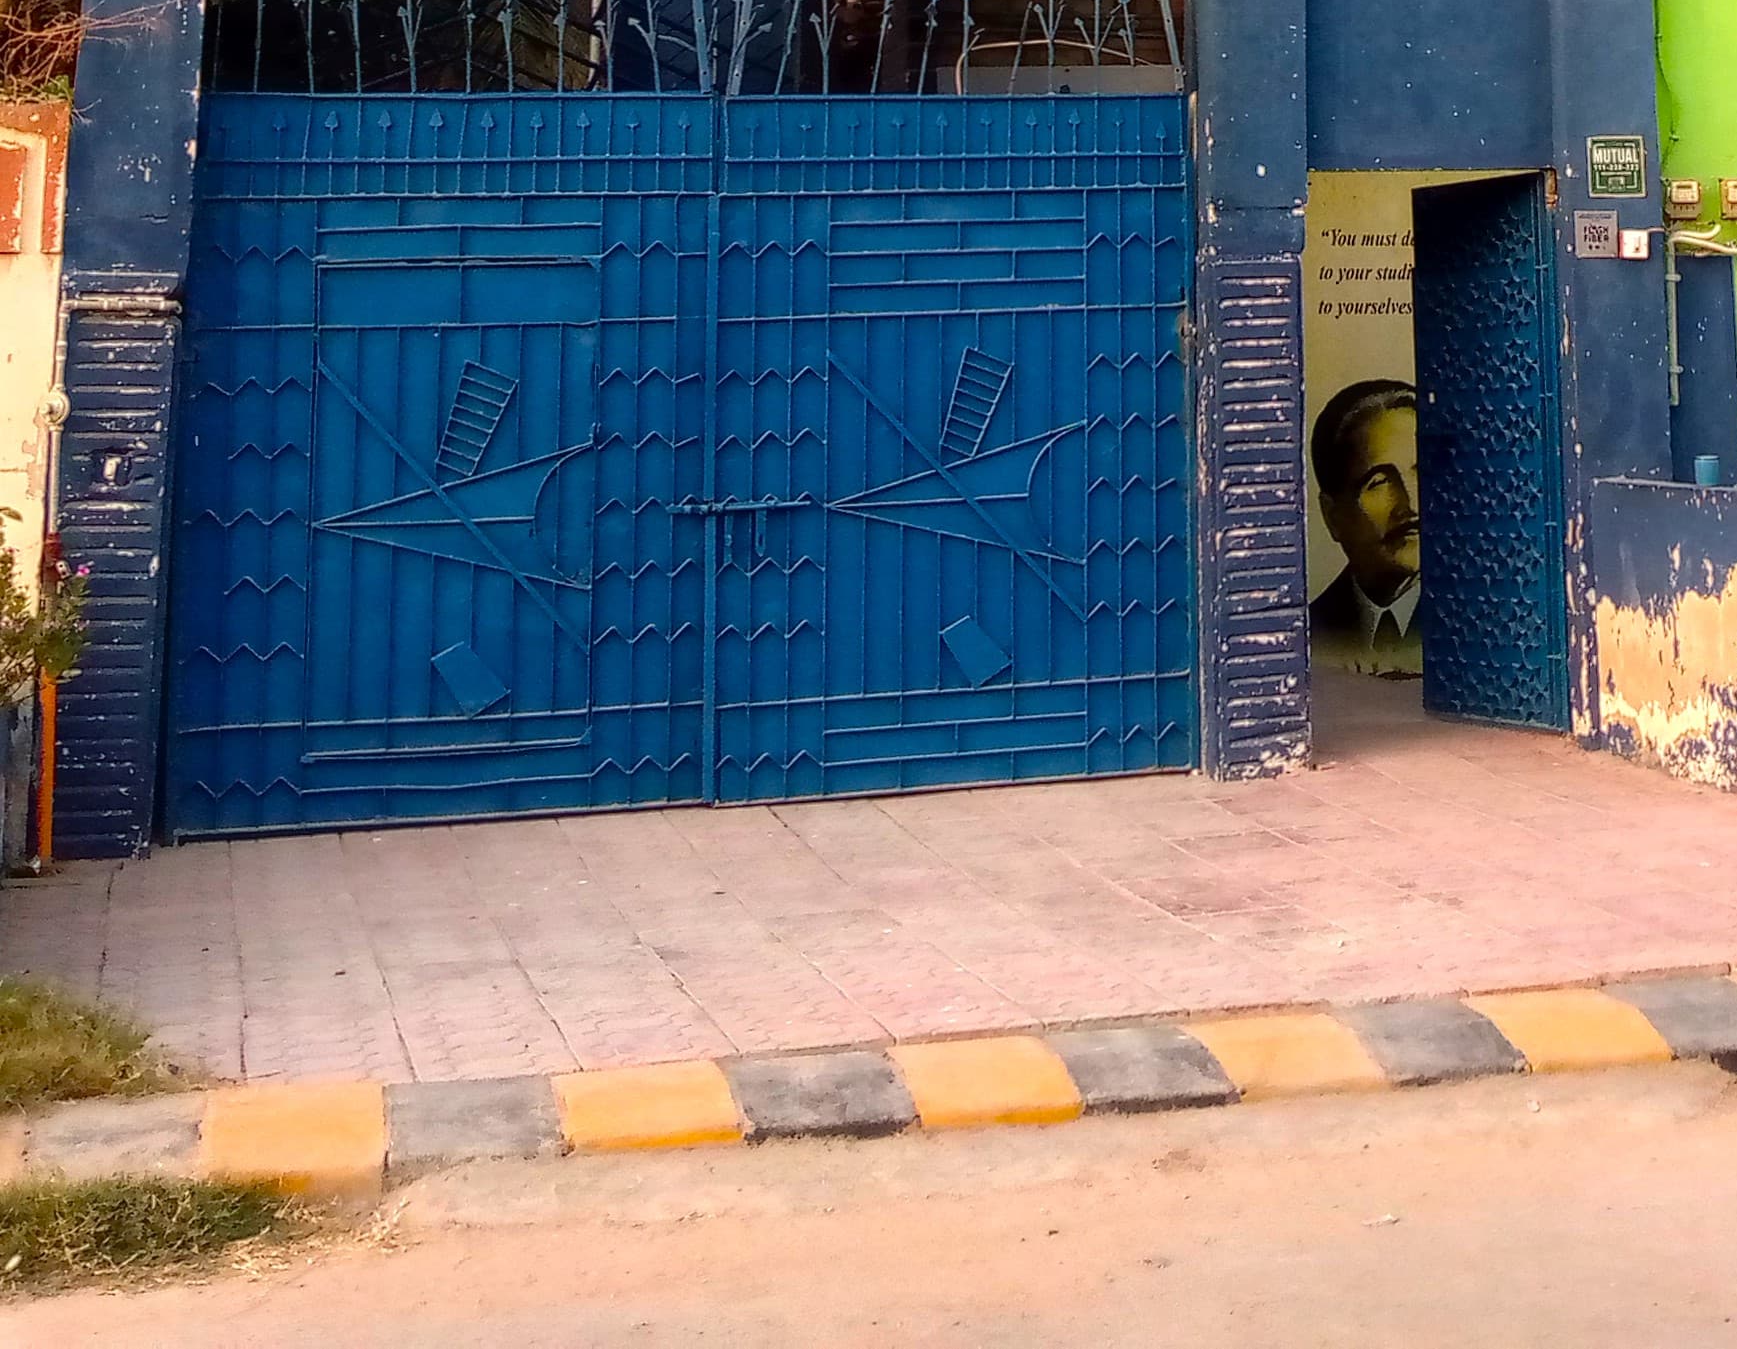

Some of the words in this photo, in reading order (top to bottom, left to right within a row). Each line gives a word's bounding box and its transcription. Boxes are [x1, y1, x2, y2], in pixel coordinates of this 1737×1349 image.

[1592, 147, 1639, 163] MUTUAL
[1360, 231, 1397, 246] must
[1319, 265, 1333, 280] to
[1336, 267, 1373, 285] your
[1375, 263, 1414, 280] studi
[1318, 299, 1333, 315] to
[1335, 296, 1413, 319] yourselves
